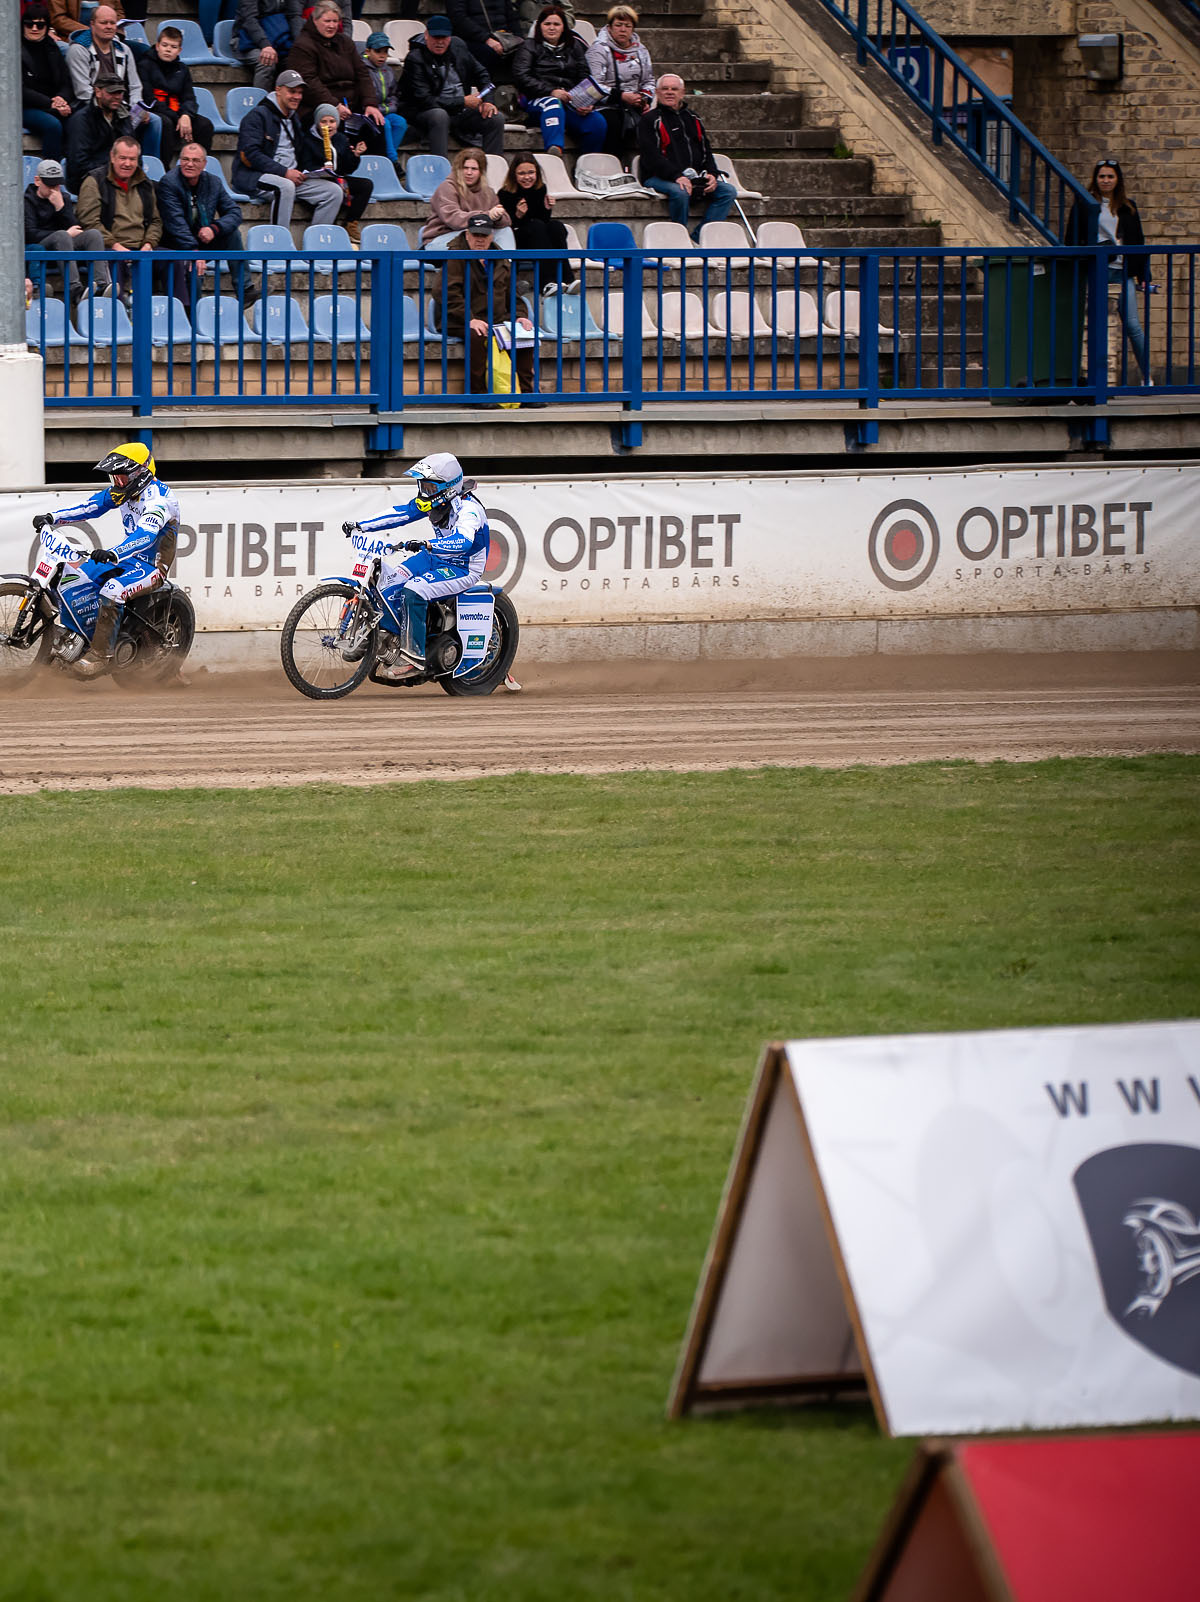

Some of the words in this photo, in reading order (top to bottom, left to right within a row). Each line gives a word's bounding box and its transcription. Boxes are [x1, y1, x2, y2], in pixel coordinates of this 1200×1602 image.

[243, 96, 254, 106] 42
[320, 234, 331, 243] 41
[377, 234, 388, 244] 42
[906, 267, 913, 281] 2
[956, 502, 1153, 561] OPTIBET
[169, 522, 324, 578] PTIBET
[543, 513, 741, 572] OPTIBET
[955, 565, 1062, 580] SPORTA
[1084, 560, 1151, 576] BĀRS
[541, 577, 650, 591] SPORTA
[672, 572, 739, 588] BĀRS
[459, 612, 490, 621] wemoto.cz
